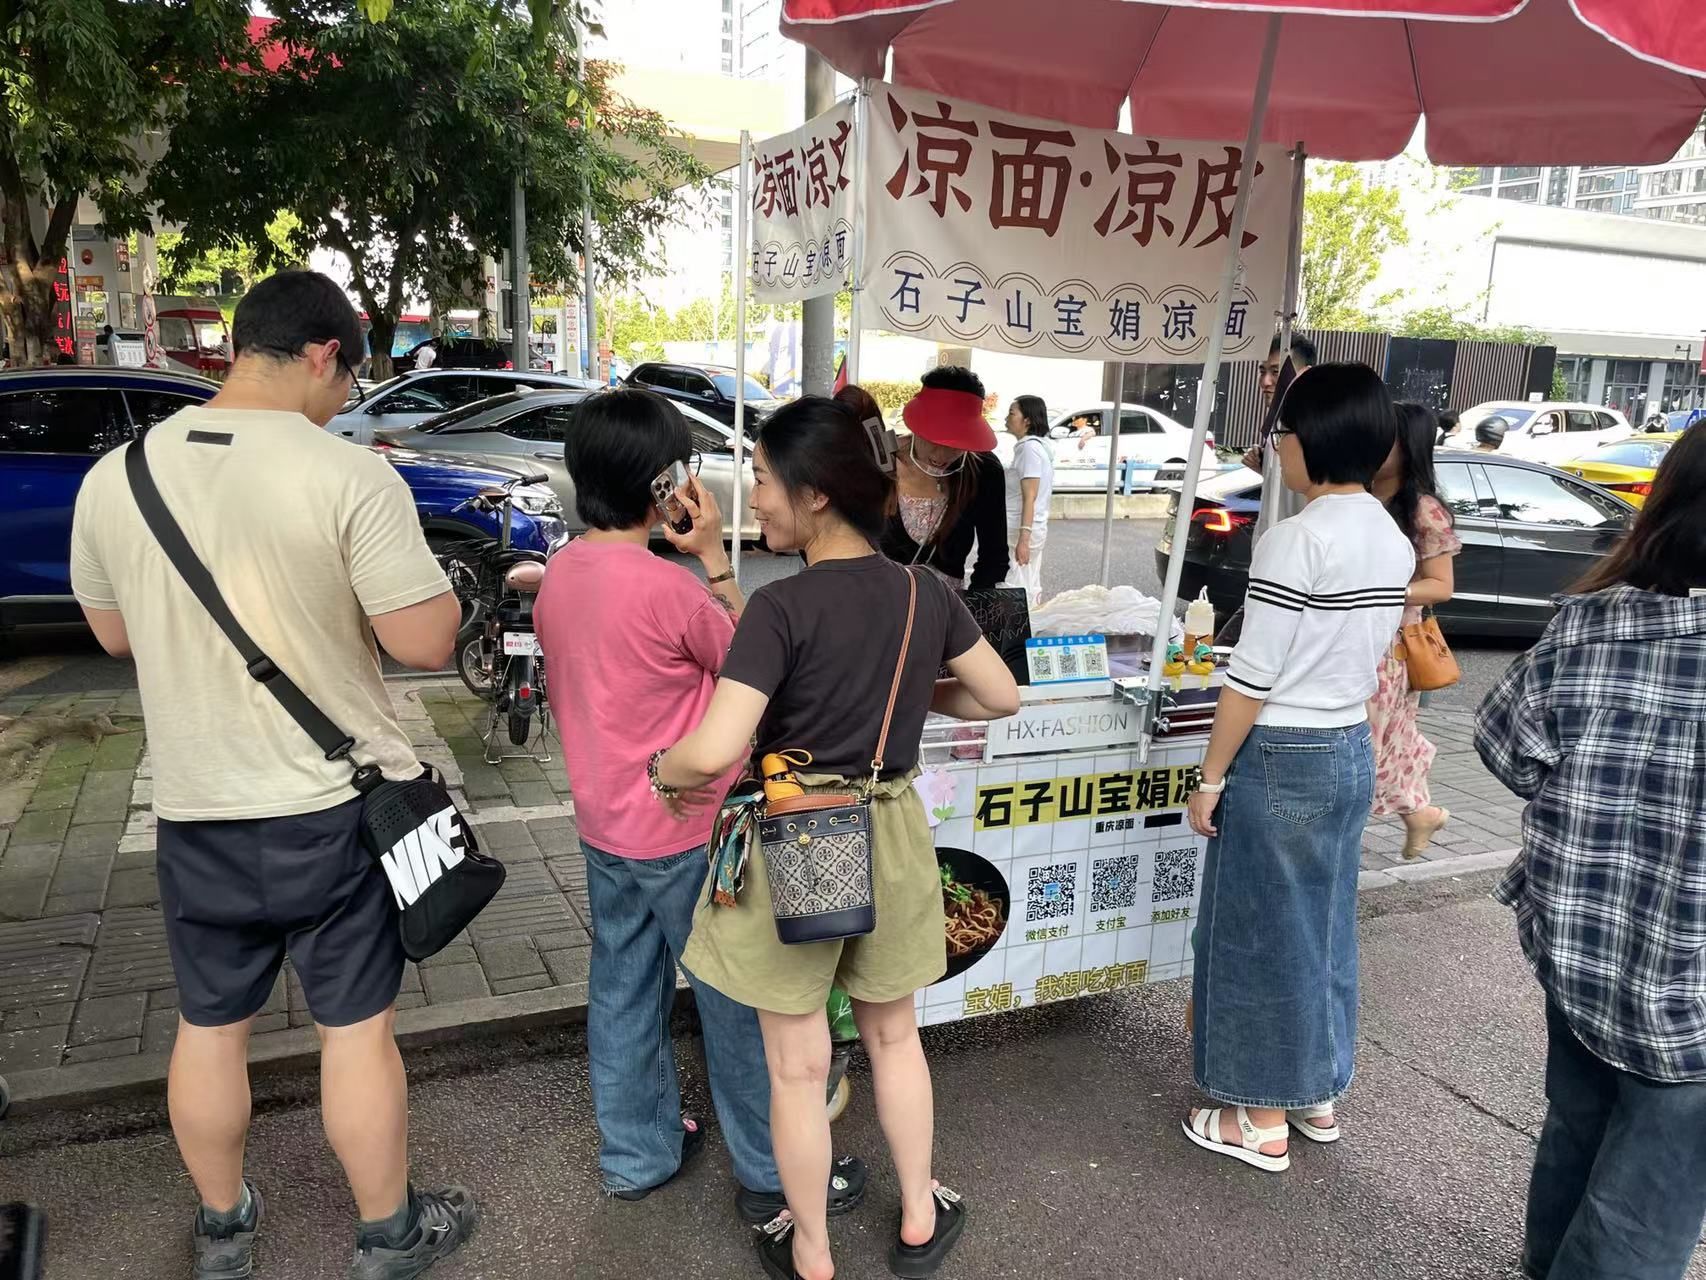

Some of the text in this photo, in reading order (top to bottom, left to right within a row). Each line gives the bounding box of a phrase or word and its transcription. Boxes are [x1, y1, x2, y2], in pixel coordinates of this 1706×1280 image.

[886, 91, 1263, 249] 凉面·凉皮
[889, 269, 1249, 342] 石子山宝娟凉面
[1007, 712, 1128, 740] HX·FASHION
[379, 804, 466, 912] NIKE
[1025, 924, 1069, 942] 微信支付
[1095, 915, 1127, 932] 支付宝
[1151, 907, 1191, 923] 添加好友
[963, 959, 1148, 1016] 宝娟，我想吃凉面
